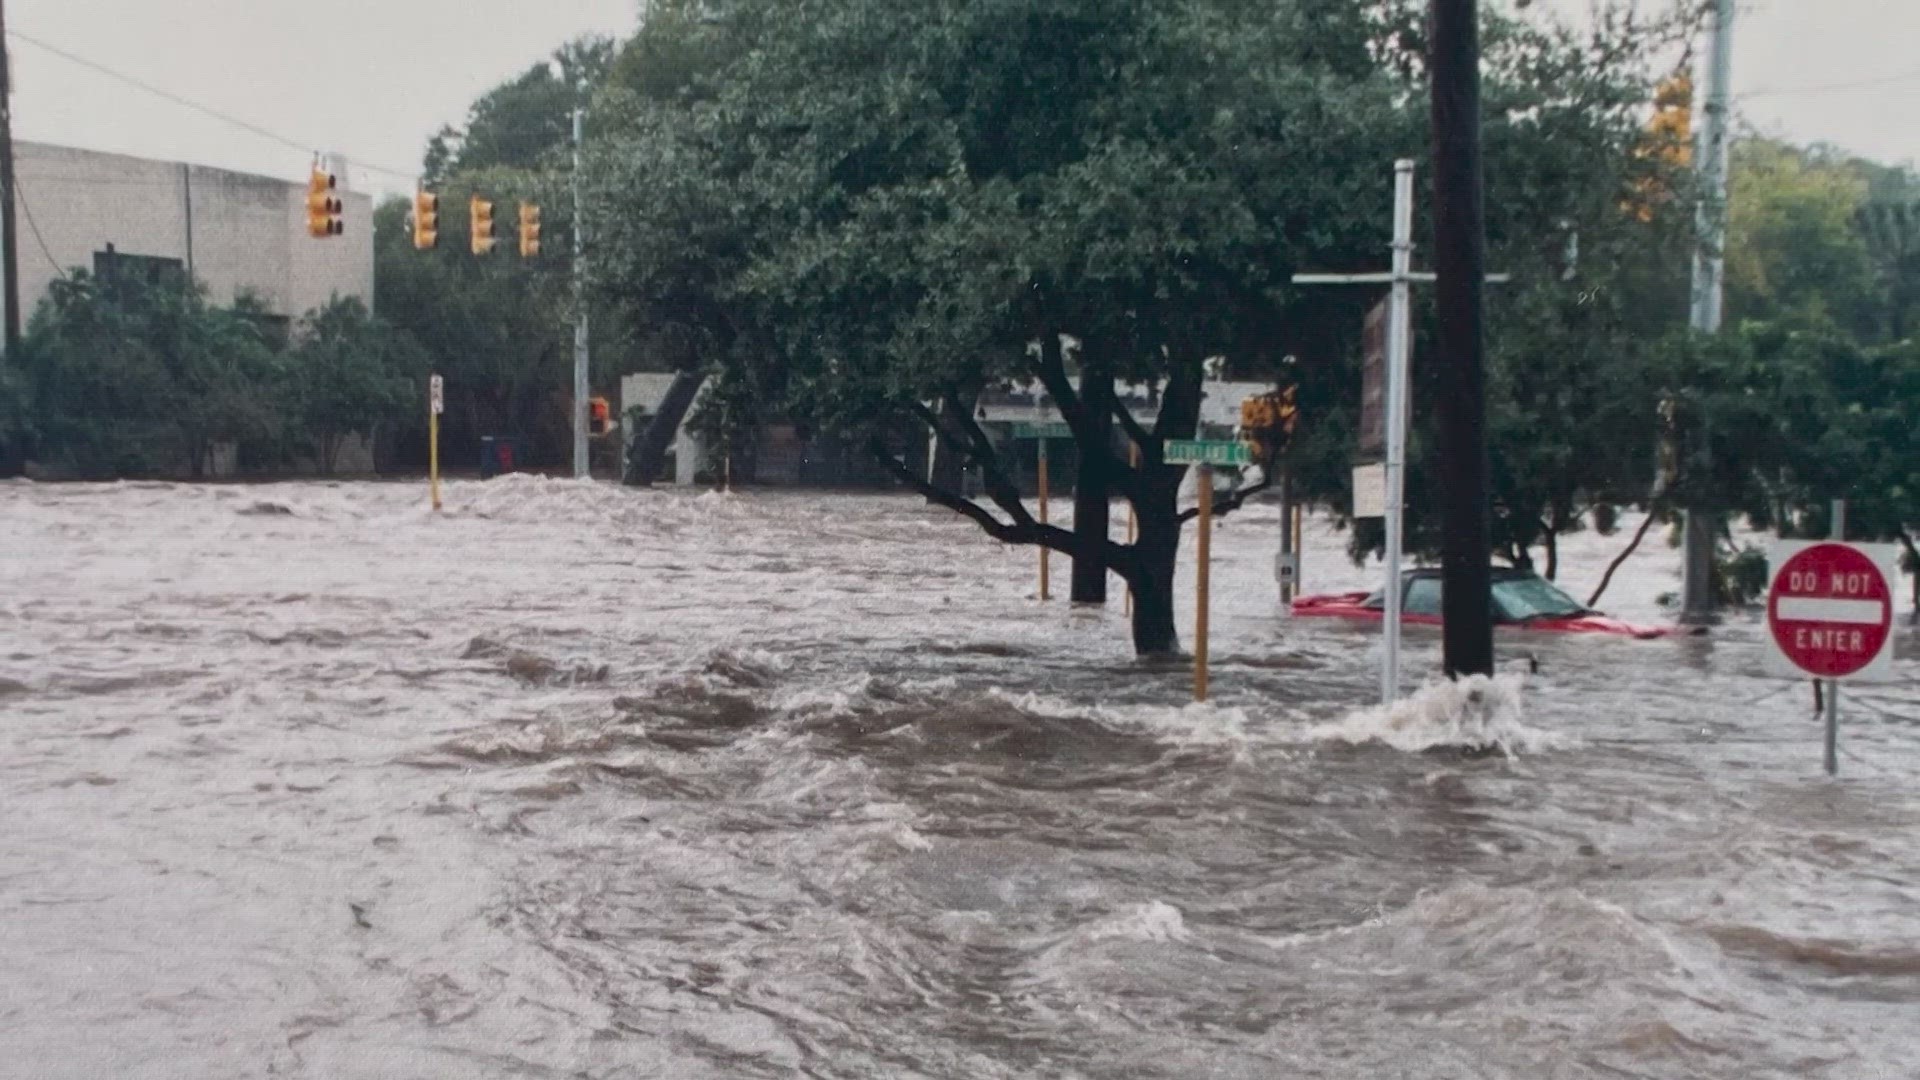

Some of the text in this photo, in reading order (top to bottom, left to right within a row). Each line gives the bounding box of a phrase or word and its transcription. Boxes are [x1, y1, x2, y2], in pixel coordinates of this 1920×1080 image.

[1790, 571, 1871, 594] DO NOT
[1796, 628, 1862, 651] ENTER
